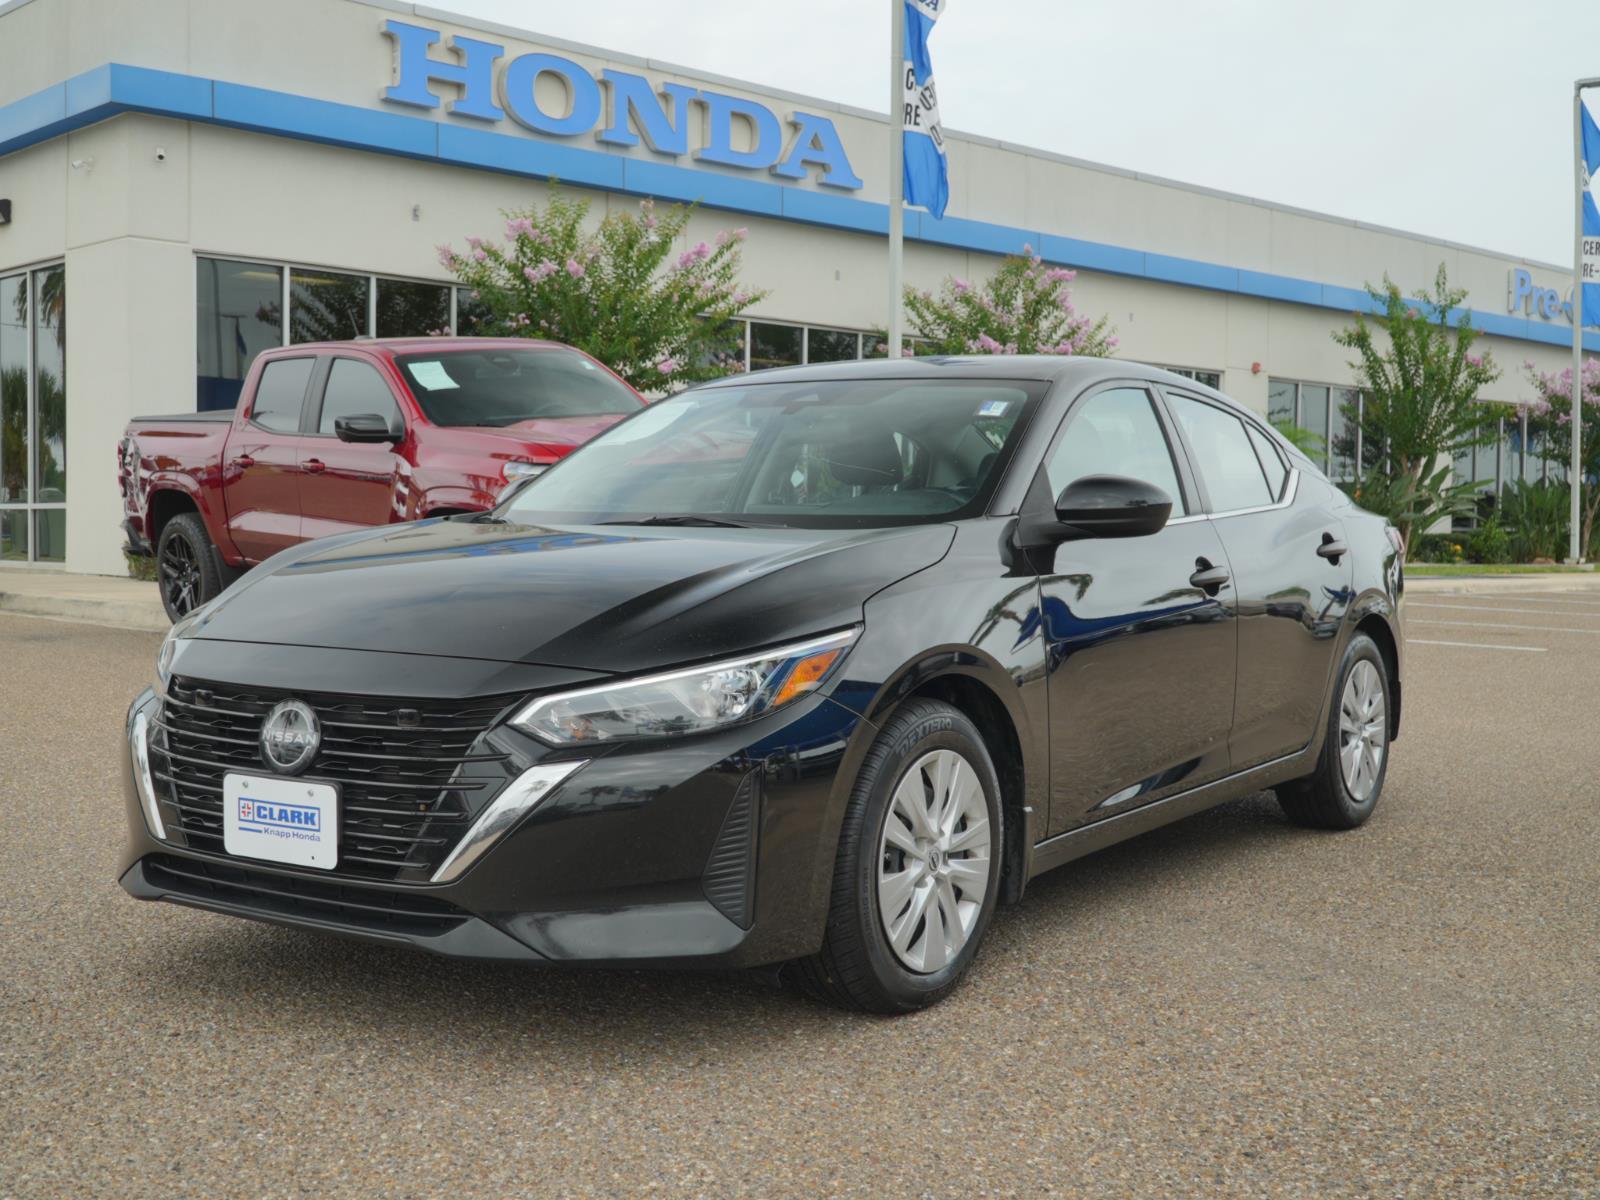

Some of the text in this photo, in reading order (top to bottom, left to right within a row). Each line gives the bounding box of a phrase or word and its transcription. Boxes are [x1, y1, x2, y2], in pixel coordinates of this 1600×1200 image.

[380, 19, 864, 191] HONDA
[903, 103, 921, 127] RE
[1508, 268, 1574, 323] Pre-
[262, 729, 316, 745] NISSAN
[256, 806, 317, 826] CLARK
[263, 827, 321, 842] Knapp Honda
